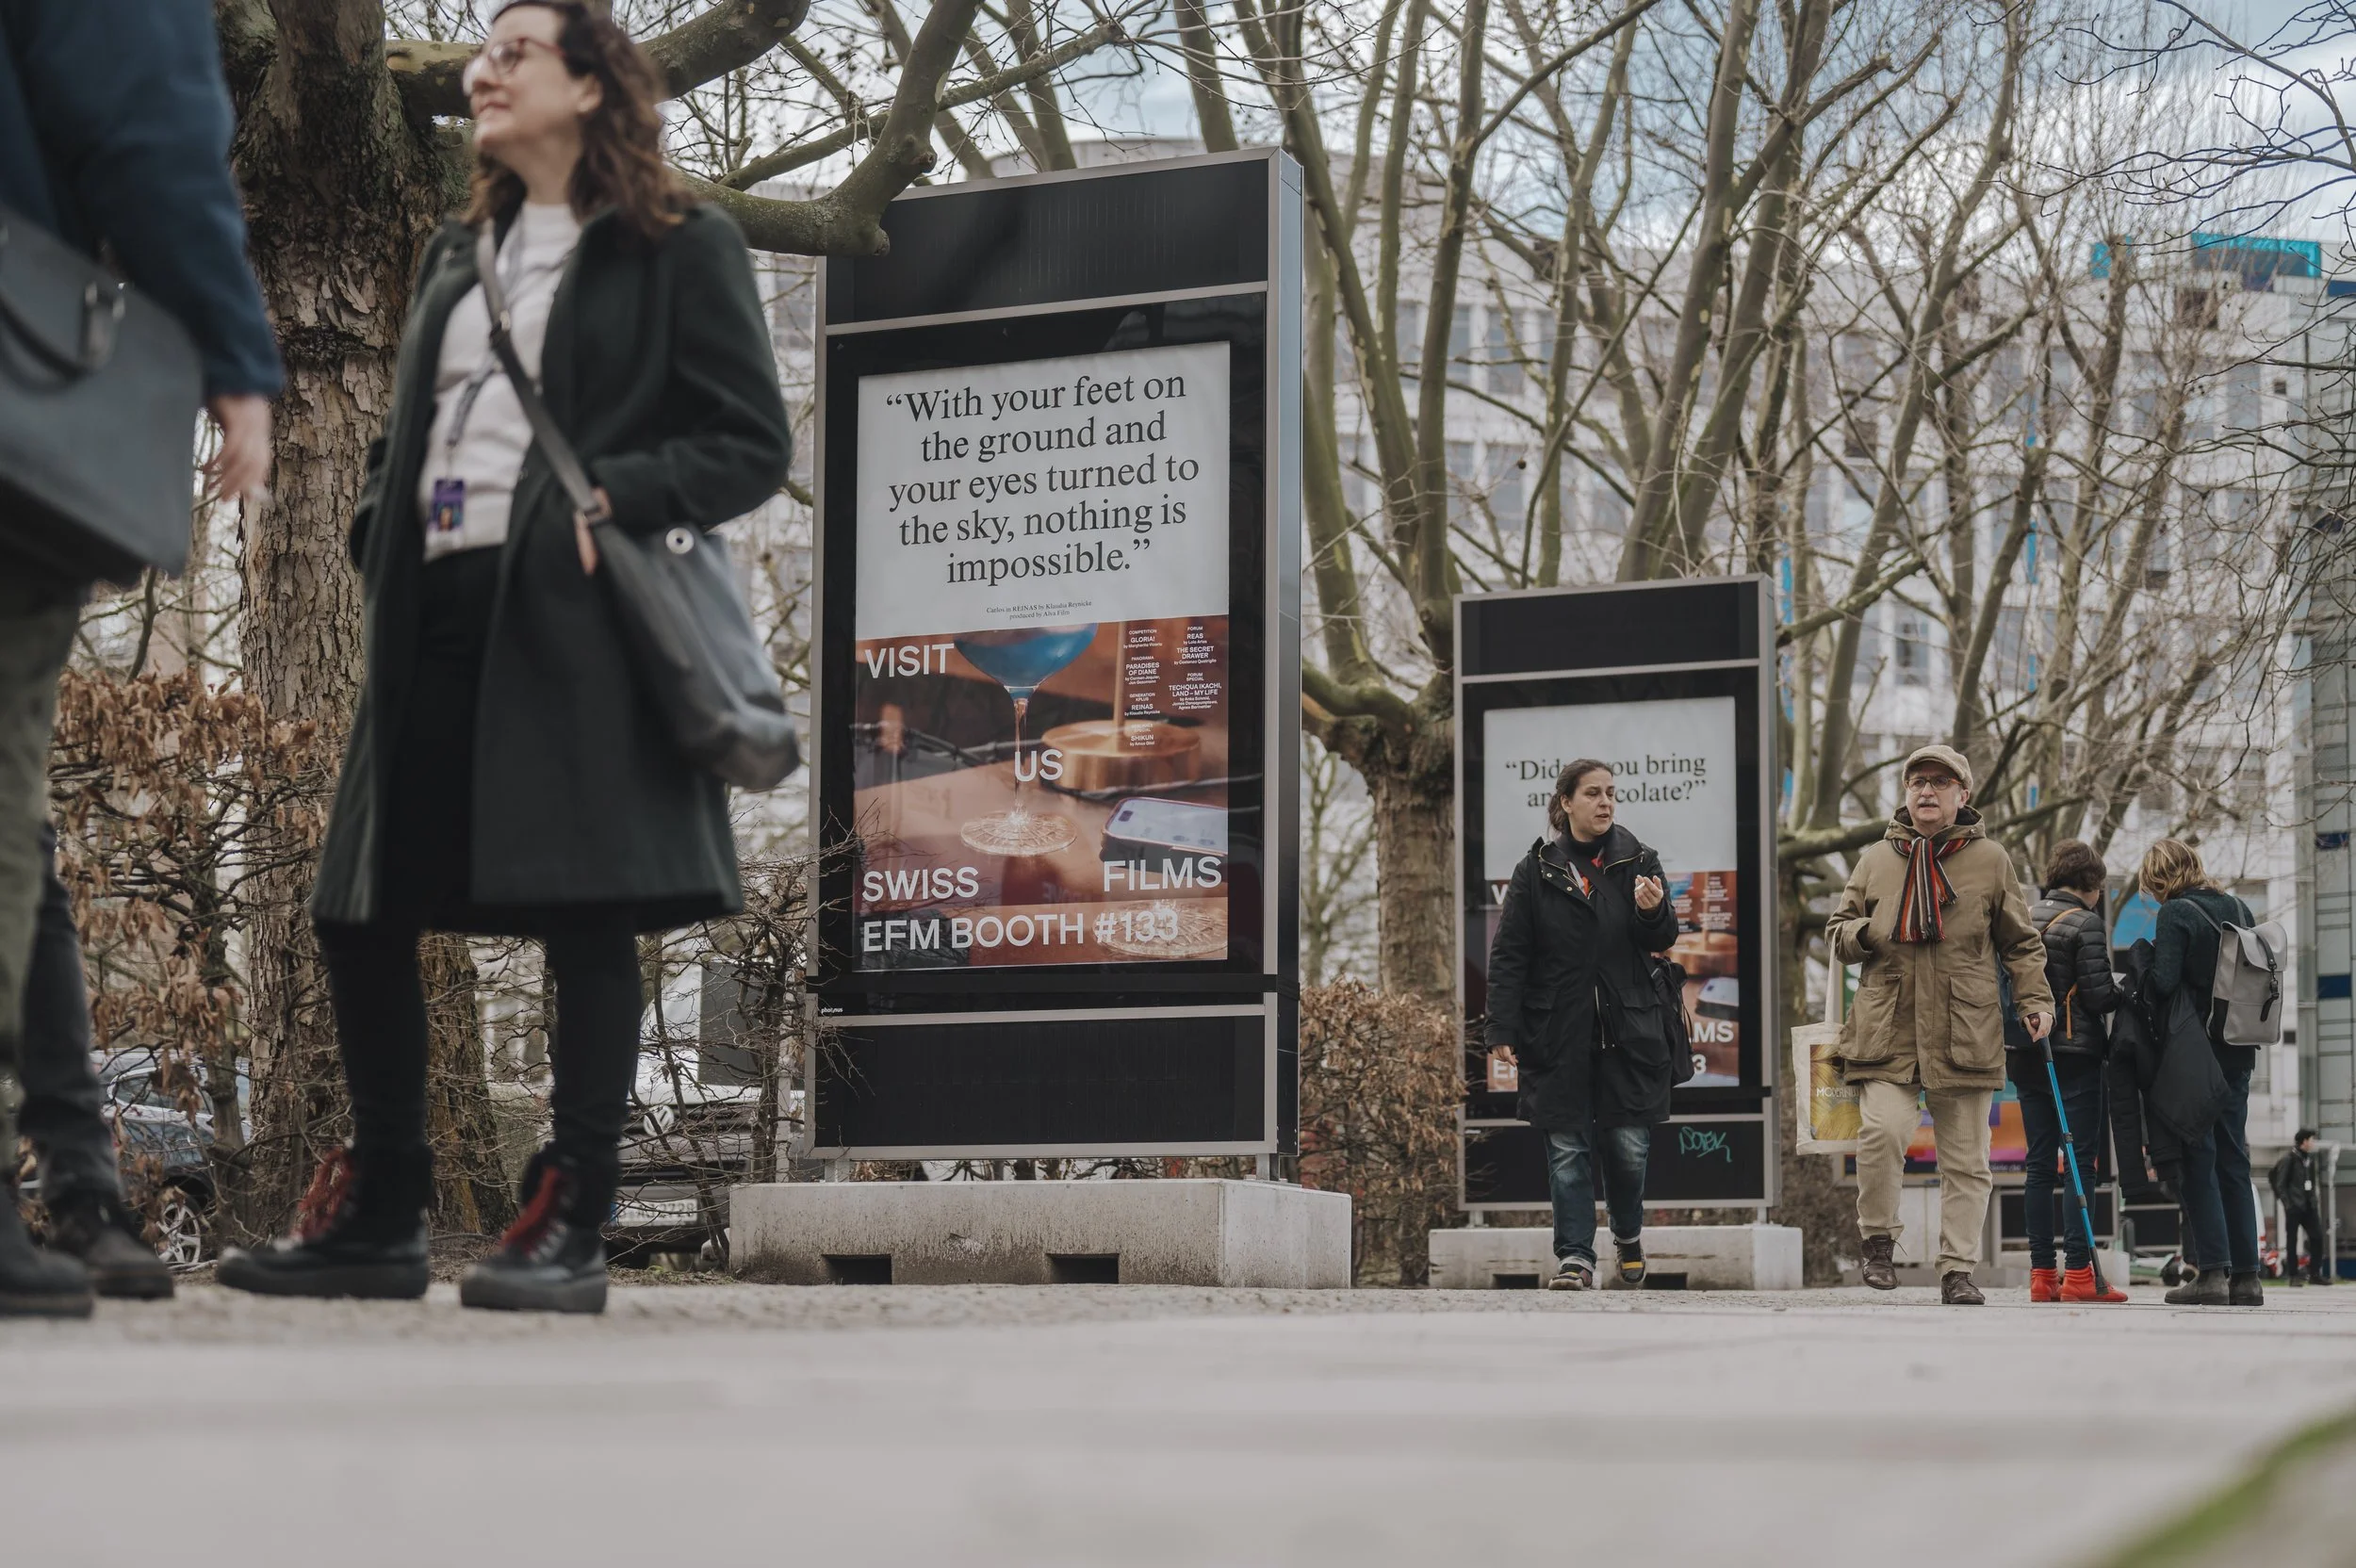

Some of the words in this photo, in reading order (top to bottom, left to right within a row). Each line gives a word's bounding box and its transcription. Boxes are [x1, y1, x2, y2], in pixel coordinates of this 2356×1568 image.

[887, 386, 983, 422] “With
[991, 385, 1066, 421] your
[1072, 375, 1135, 407] feet
[1143, 375, 1186, 400] on
[921, 430, 969, 462] the
[978, 416, 1096, 463] ground
[1105, 410, 1167, 446] and
[889, 478, 960, 512] your
[969, 471, 1038, 503] eyes
[1047, 452, 1156, 493] turned
[1165, 455, 1200, 482] to
[899, 514, 948, 546] the
[957, 509, 1015, 545] sky,
[1023, 498, 1153, 533] nothing
[1160, 494, 1186, 525] is
[947, 538, 1150, 586] impossible.”
[1009, 612, 1035, 620] produced
[1068, 600, 1092, 609] Reynicke
[865, 643, 955, 678] VISIT
[1125, 662, 1160, 670] PARADISES
[1014, 748, 1064, 782] US
[1609, 760, 1639, 776] ou
[1646, 752, 1707, 777] bring
[1528, 790, 1553, 808] an
[861, 866, 980, 903] SWISS
[1103, 856, 1222, 892] FILMS
[863, 918, 940, 953] EFM
[951, 912, 1084, 950] BOOTH
[1095, 909, 1179, 944] #133
